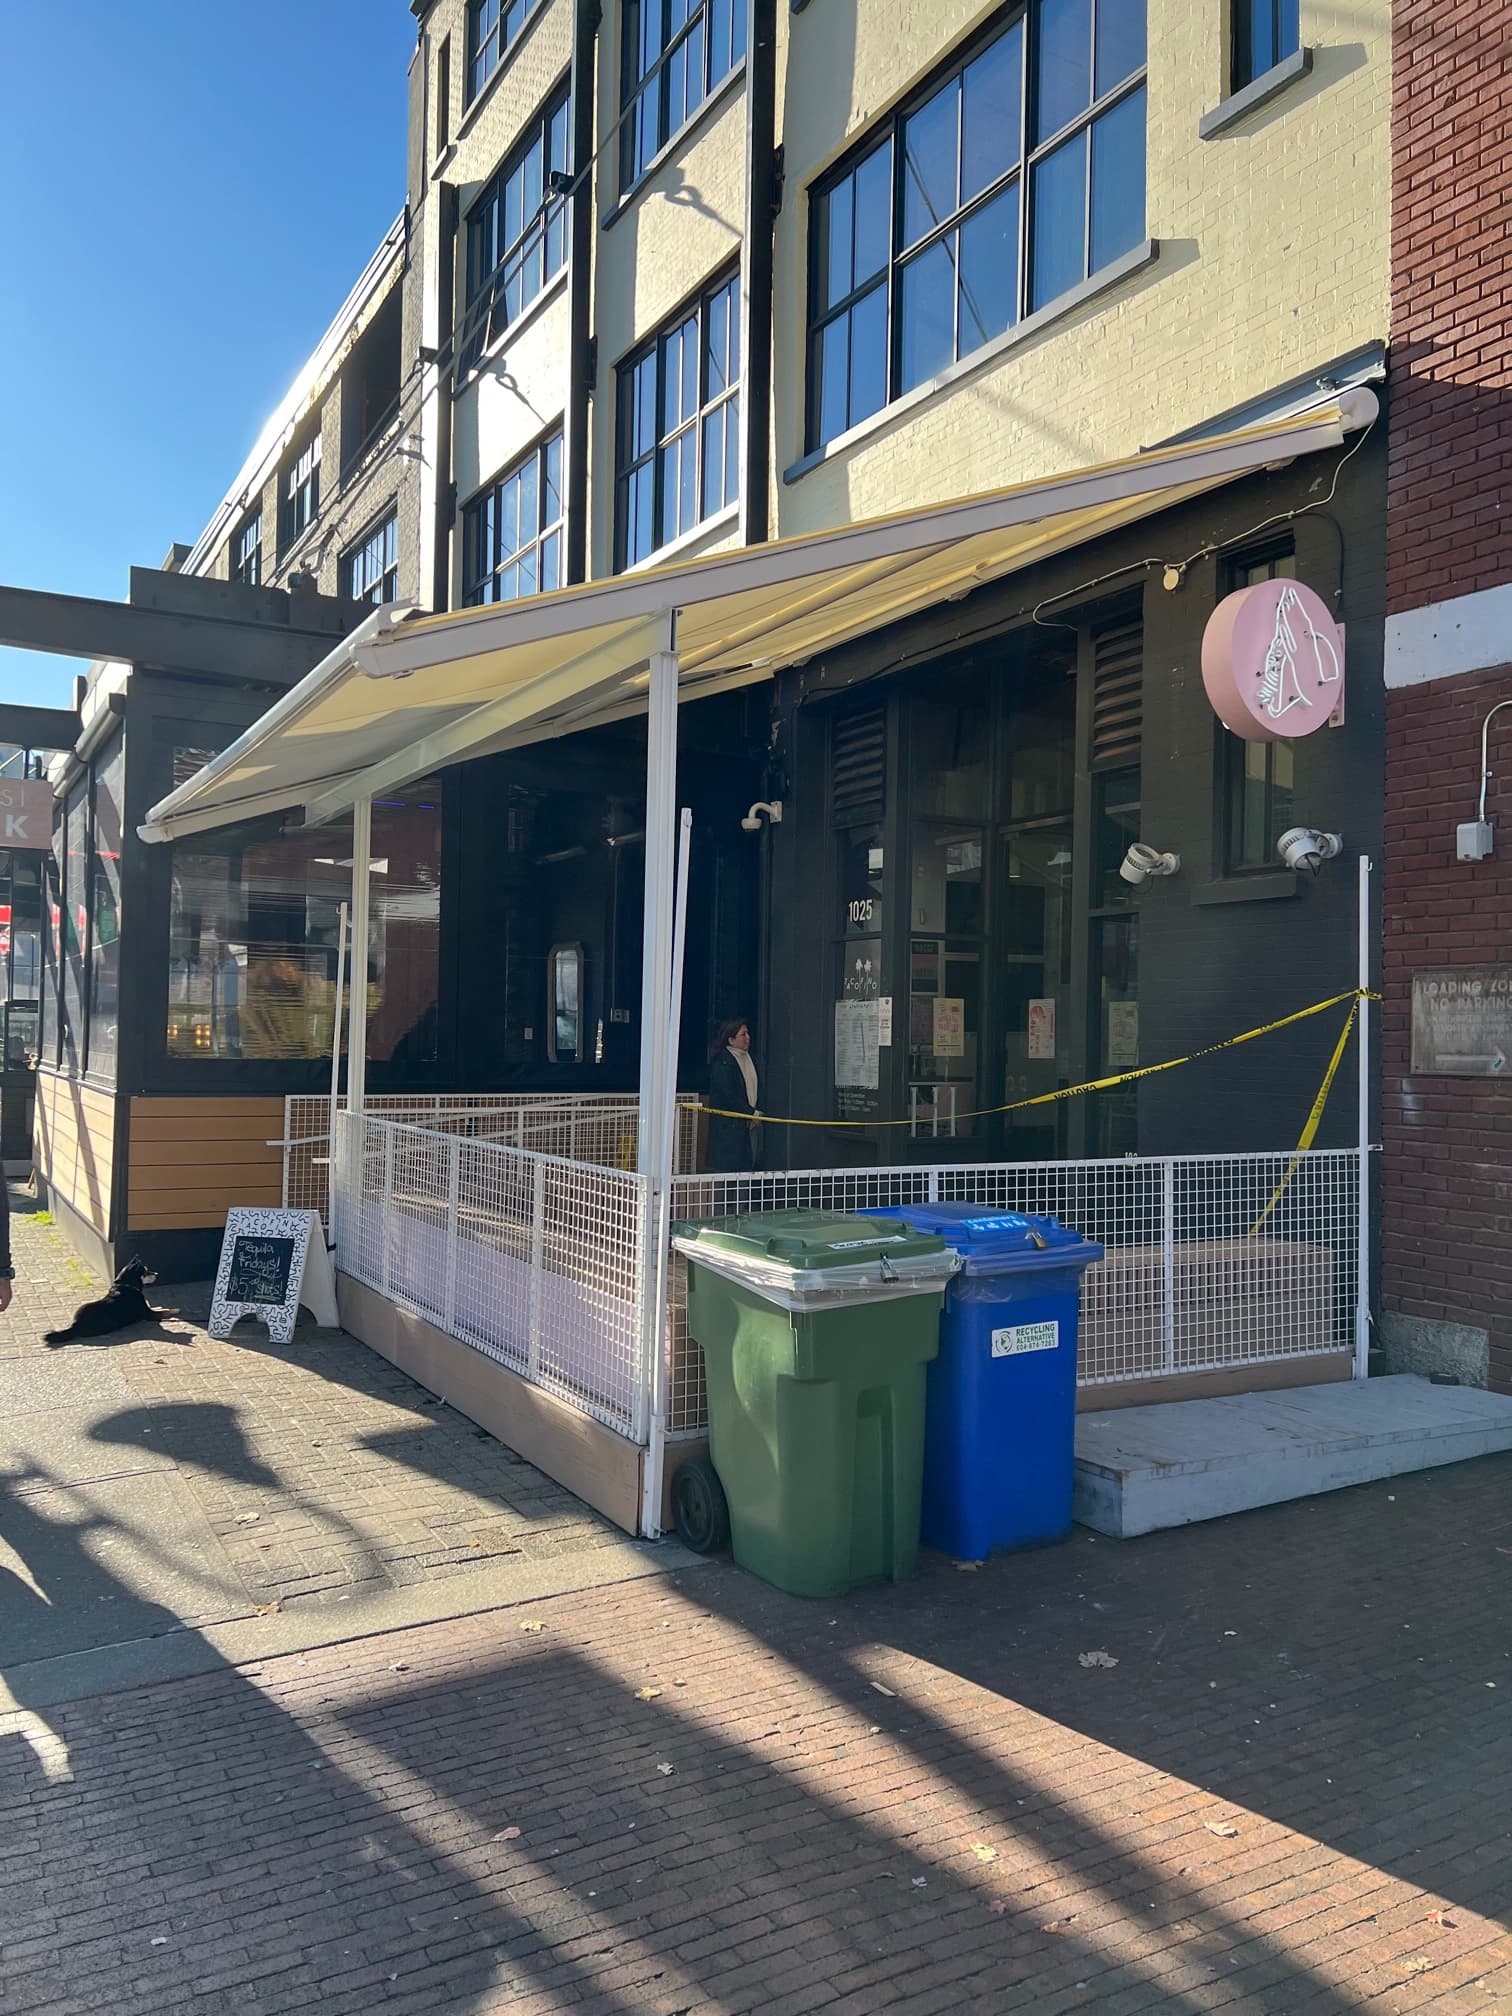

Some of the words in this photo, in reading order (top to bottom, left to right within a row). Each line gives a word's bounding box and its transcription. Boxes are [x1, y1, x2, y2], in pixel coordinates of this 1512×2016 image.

[848, 899, 873, 921] 1025
[844, 977, 877, 991] TACOFINO
[1423, 981, 1482, 994] LOADING
[1431, 998, 1449, 1010] NO
[239, 1240, 274, 1257] Tequila
[1016, 1323, 1055, 1336] RECYCLING
[1016, 1333, 1054, 1344] ALTERNATIVE
